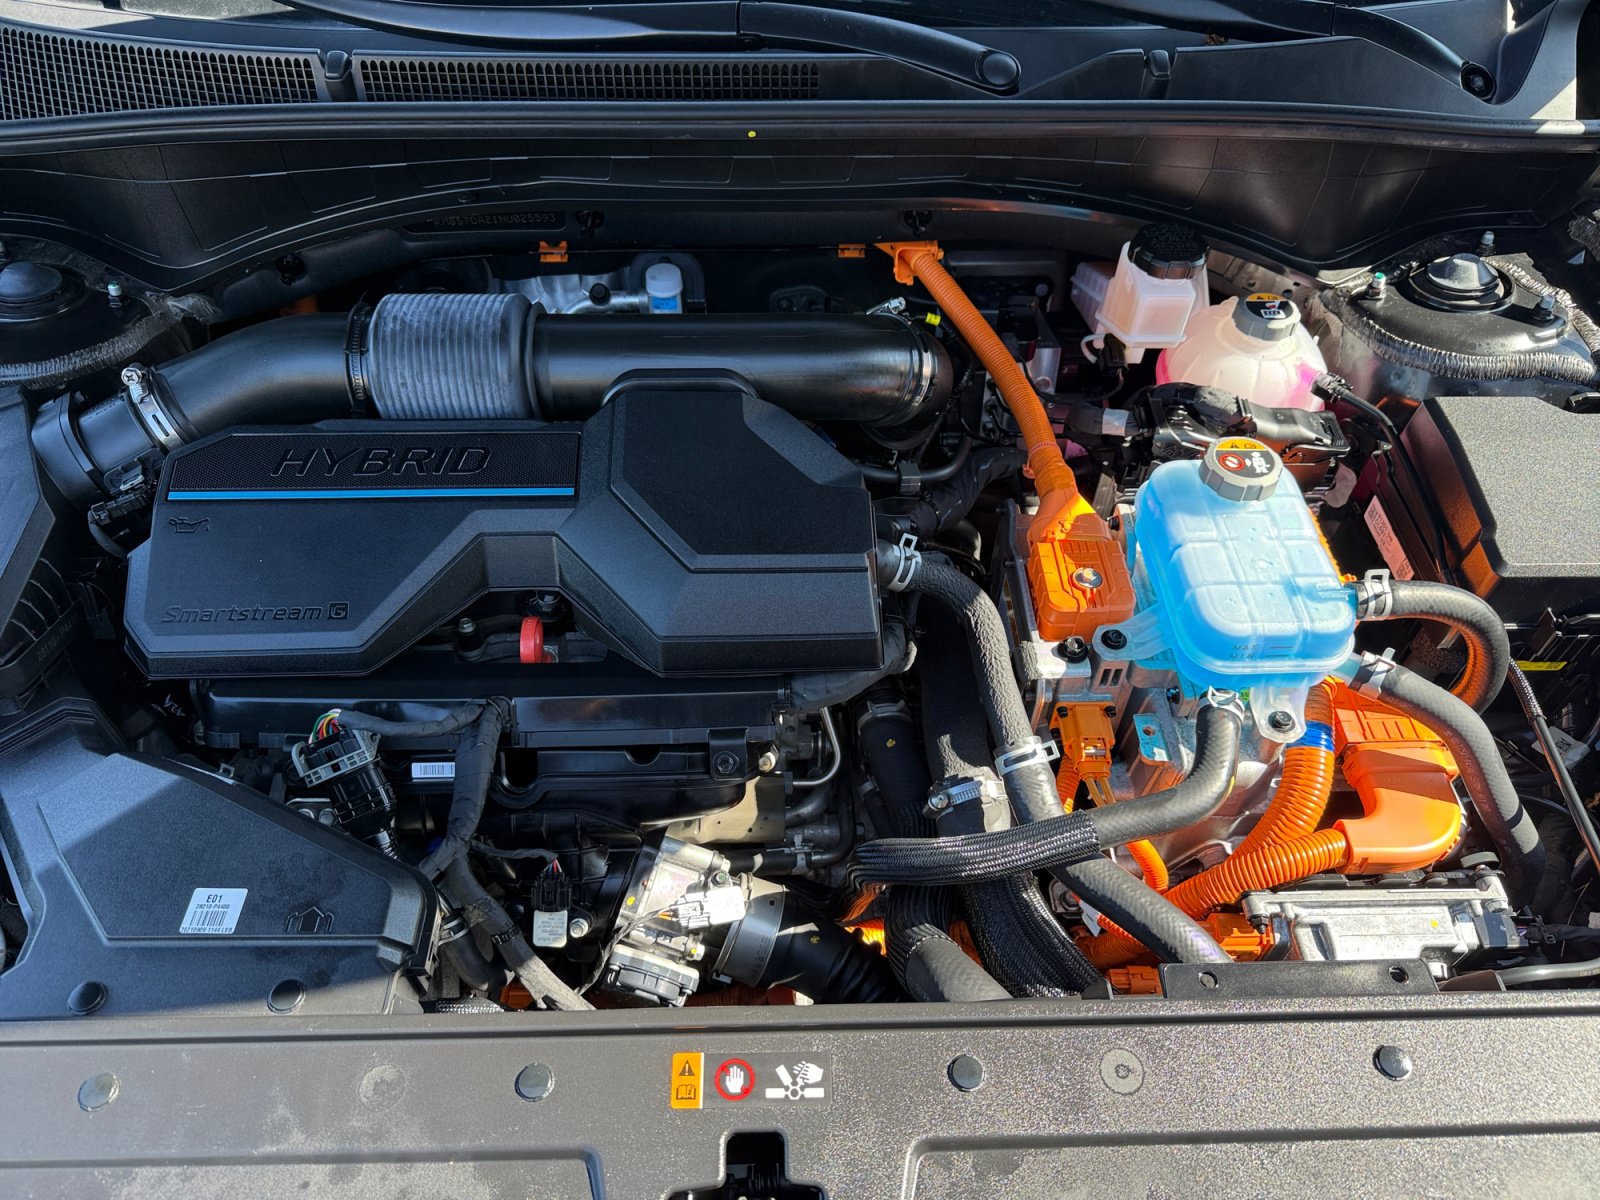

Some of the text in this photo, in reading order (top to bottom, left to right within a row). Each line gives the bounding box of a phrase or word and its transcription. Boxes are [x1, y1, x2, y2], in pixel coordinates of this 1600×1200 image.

[270, 446, 492, 477] HYBRID
[161, 602, 349, 624] Smartstream G
[206, 894, 223, 903] E01
